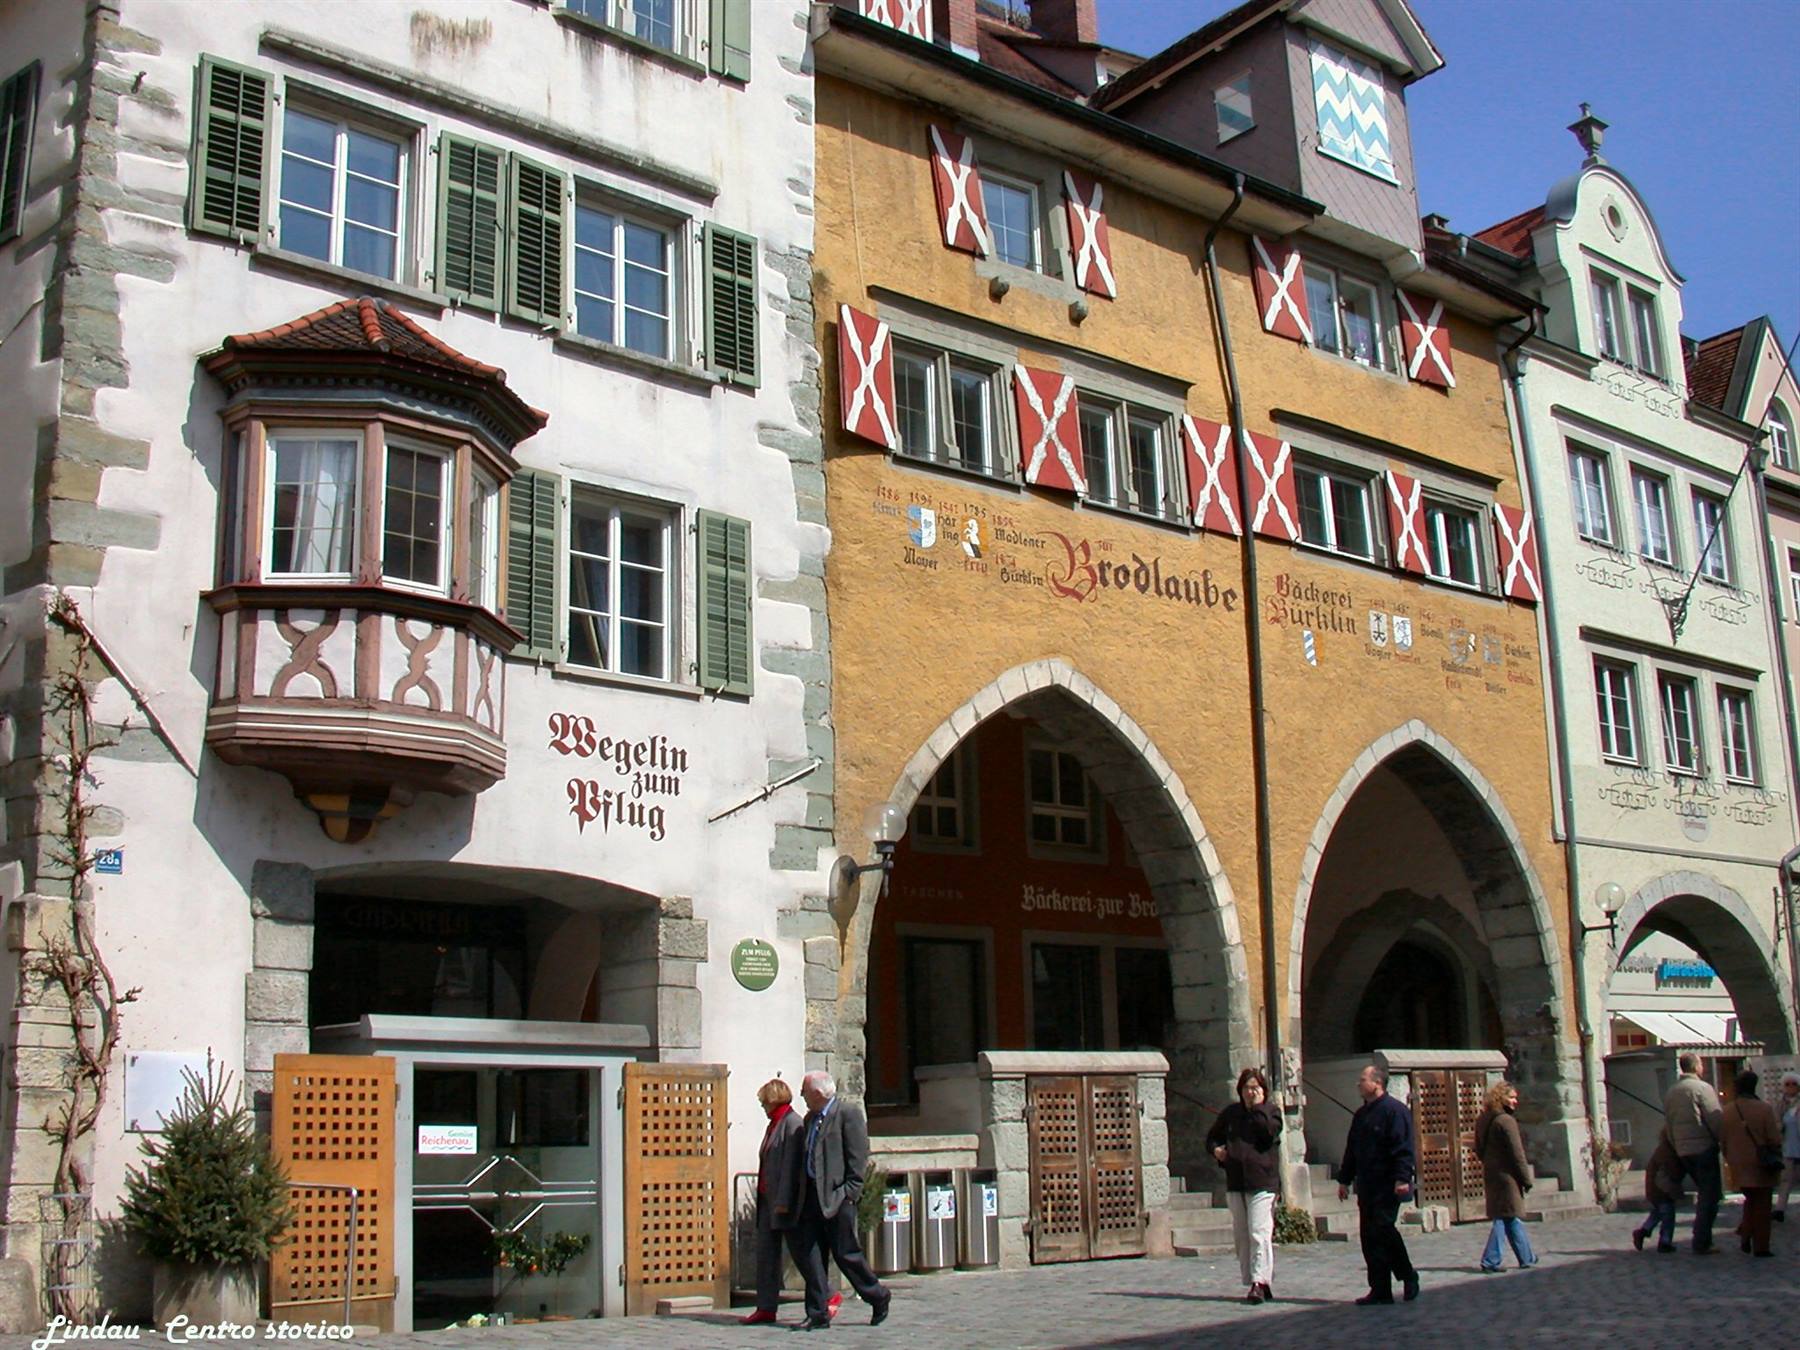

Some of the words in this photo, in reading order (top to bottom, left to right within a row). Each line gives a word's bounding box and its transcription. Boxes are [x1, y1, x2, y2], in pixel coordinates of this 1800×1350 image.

[1039, 530, 1238, 613] Brodlaube
[1276, 573, 1353, 609] Bäckerei
[1265, 594, 1358, 635] Bürklin
[547, 712, 689, 776] Wegelin
[631, 772, 680, 799] zum
[566, 777, 667, 842] Pflug
[1021, 884, 1092, 913] Bäckerei
[1096, 896, 1125, 919] zur
[421, 1135, 469, 1146] Reichenau
